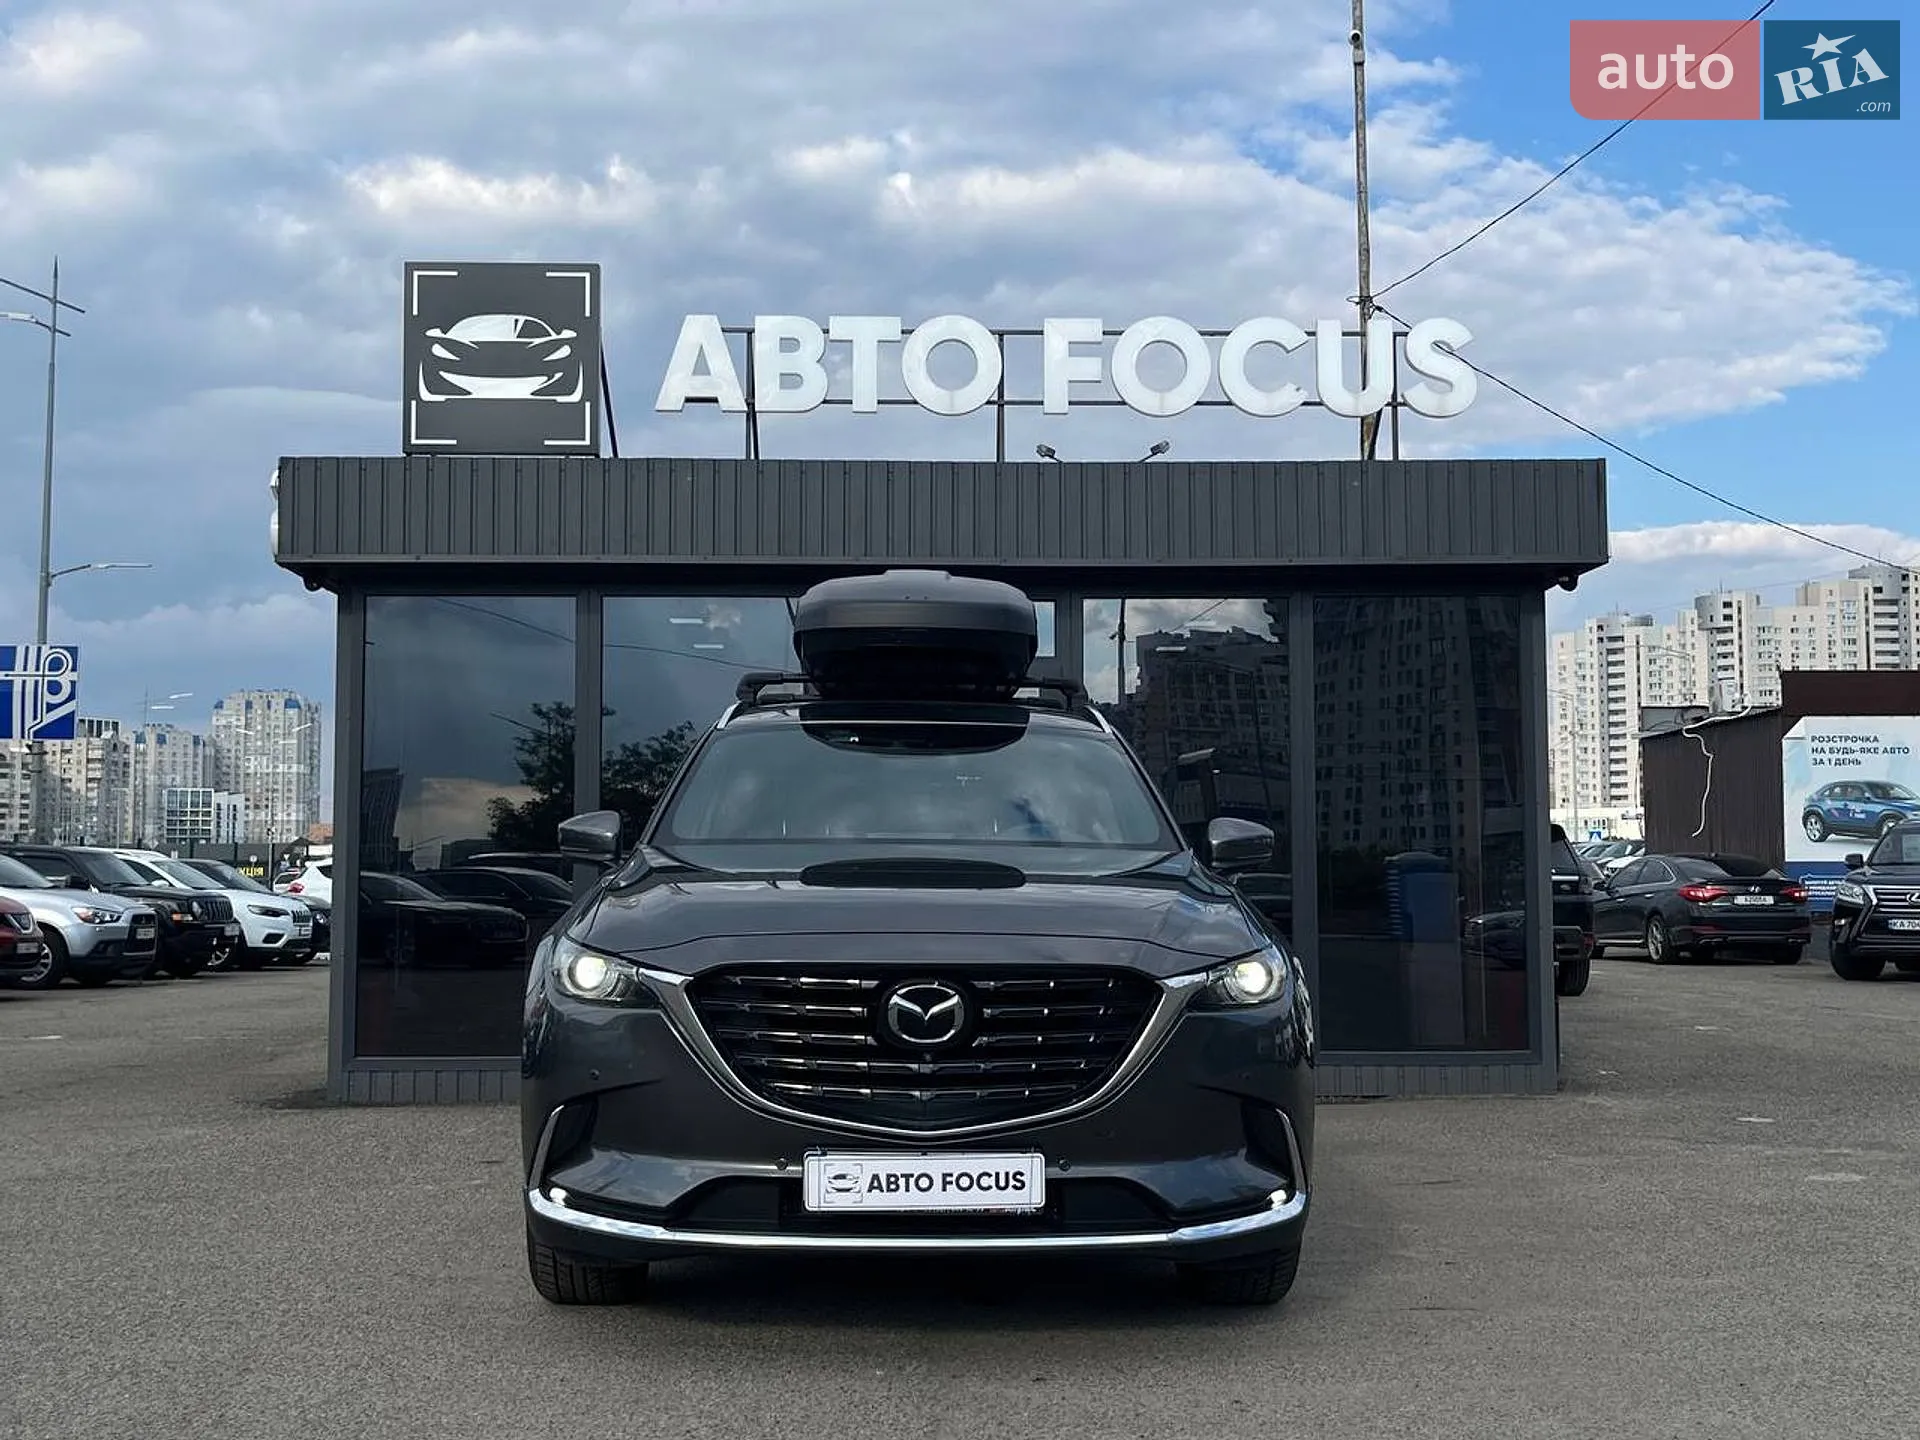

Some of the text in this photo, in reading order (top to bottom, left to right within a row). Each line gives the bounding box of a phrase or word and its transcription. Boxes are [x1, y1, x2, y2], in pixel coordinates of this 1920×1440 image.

[655, 314, 1478, 418] АВТО FOCUS
[1811, 735, 1879, 743] РОЗСТРОЧКА
[1829, 747, 1879, 755] БУДЬ-ЯКЕ
[1812, 758, 1825, 766] ЗА
[1834, 758, 1861, 766] ДЕНЬ
[866, 1171, 1026, 1193] АВТО FOCUS
